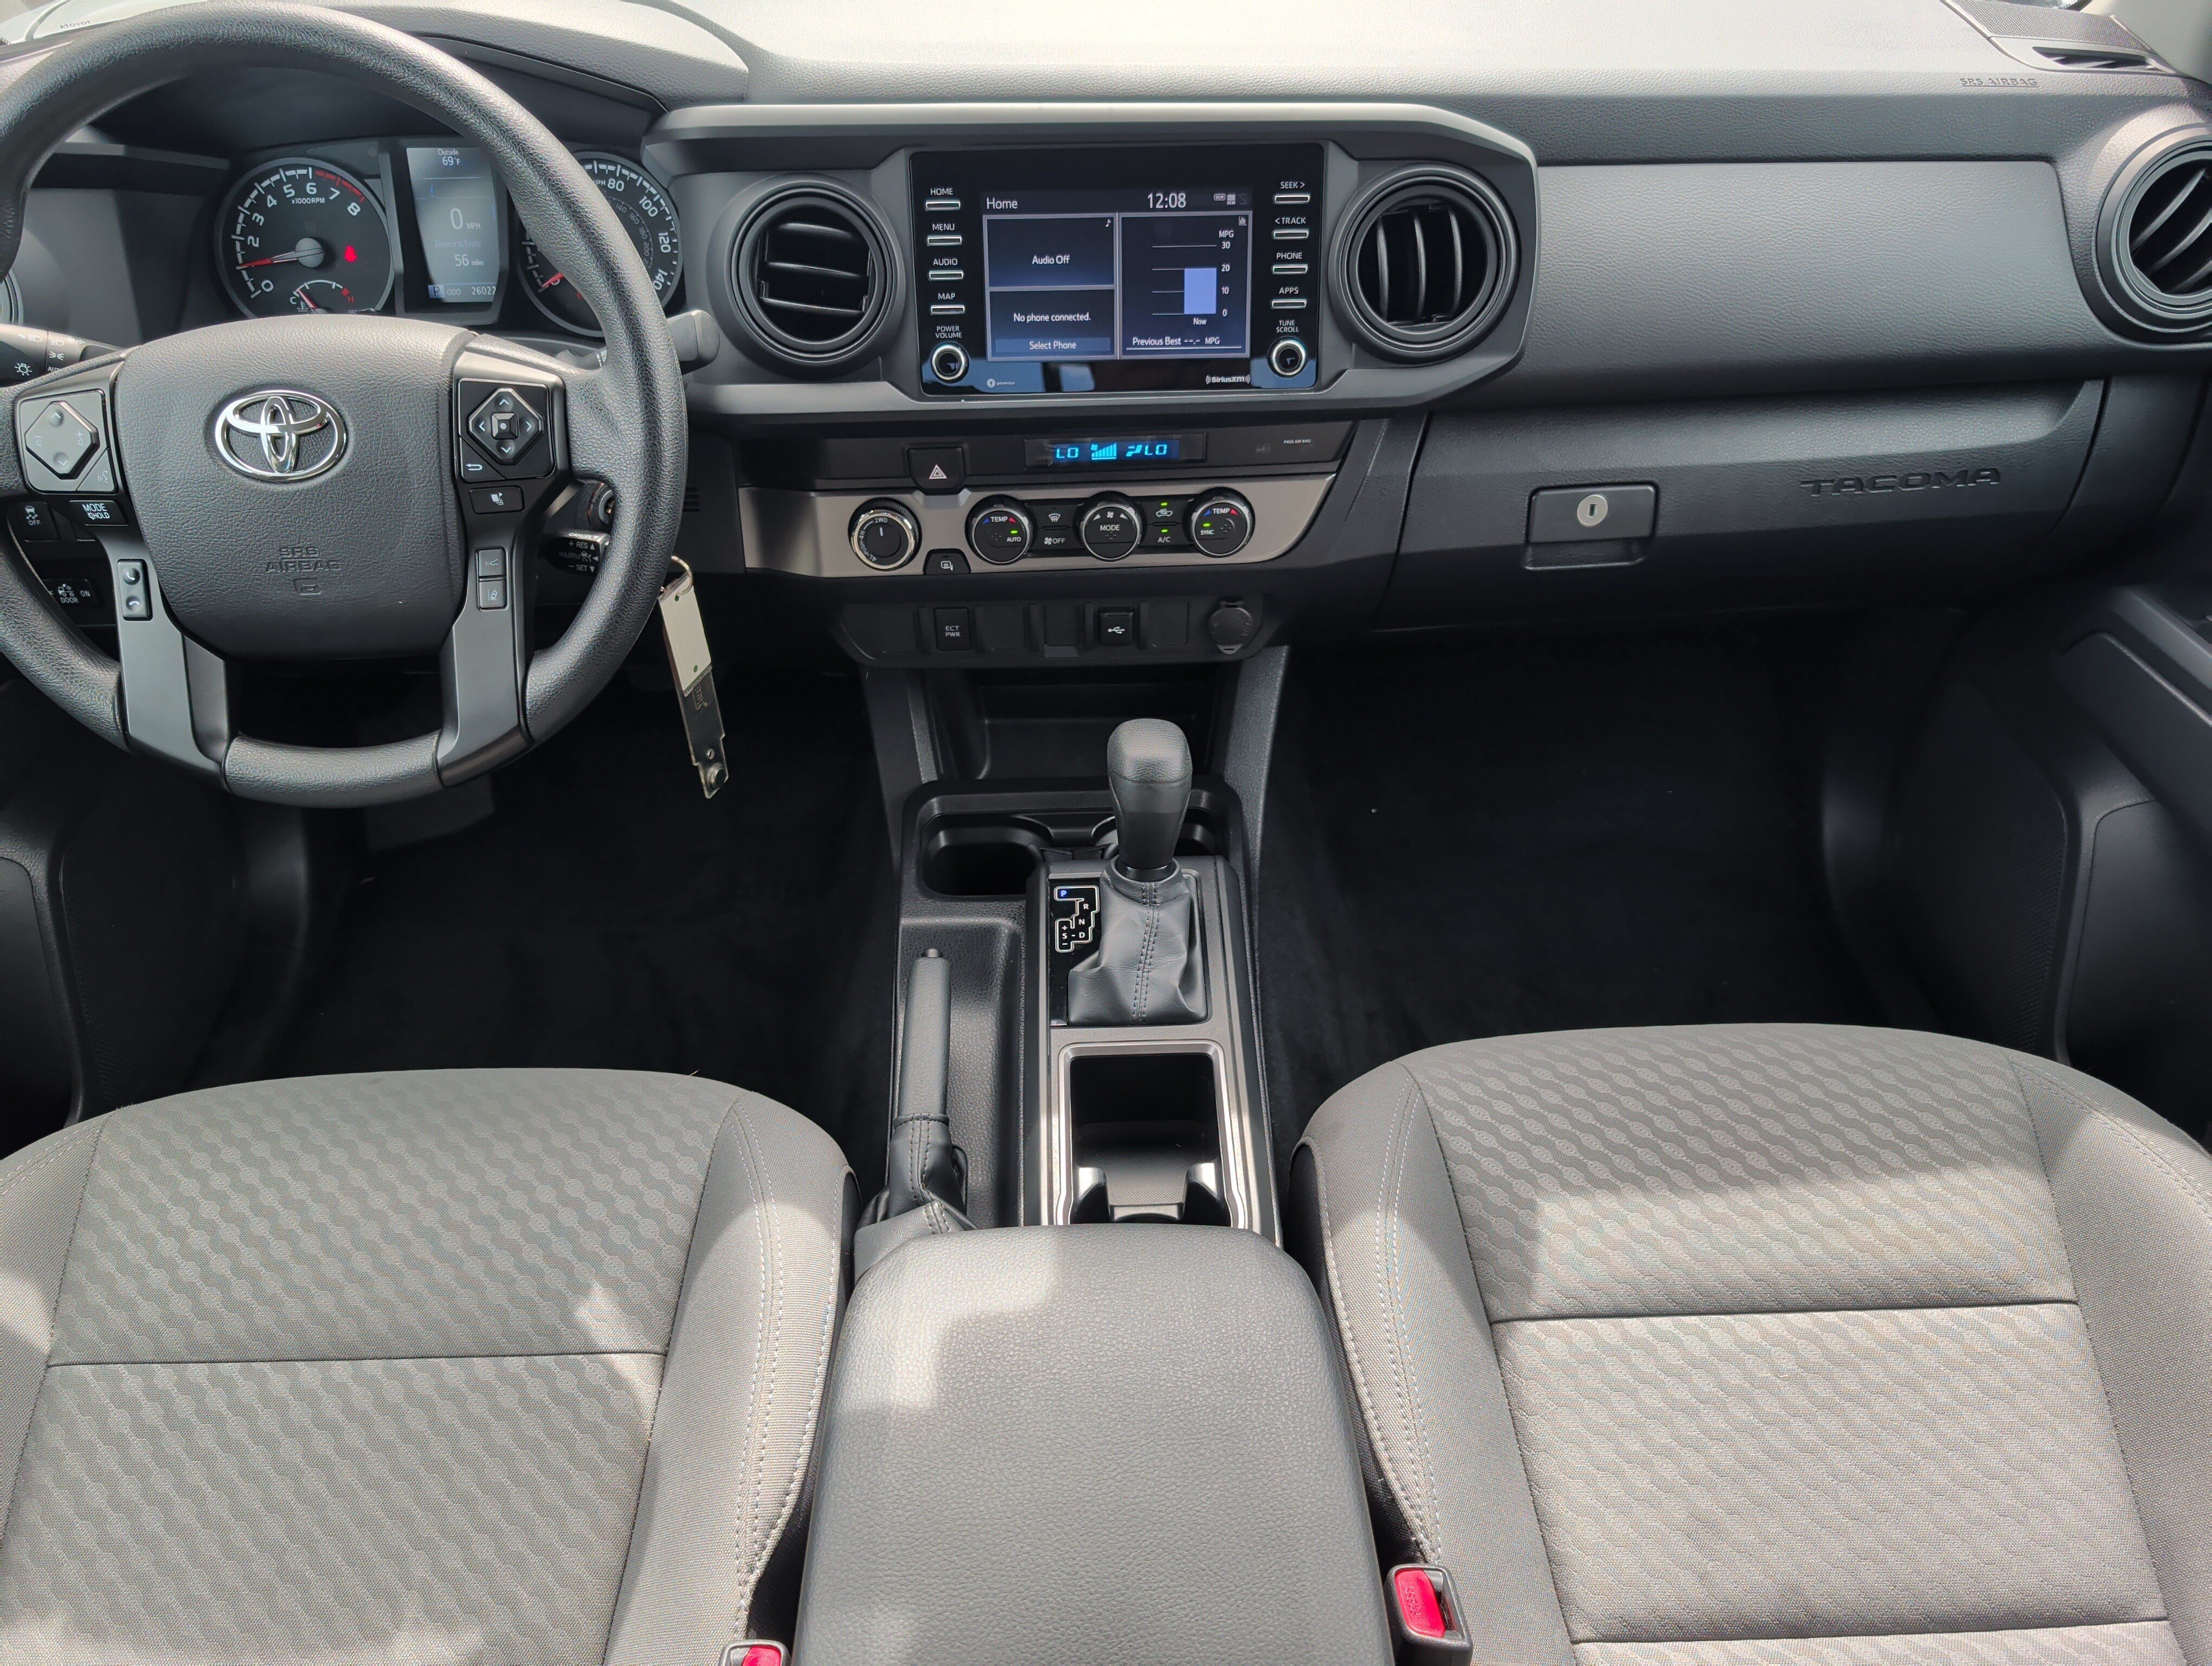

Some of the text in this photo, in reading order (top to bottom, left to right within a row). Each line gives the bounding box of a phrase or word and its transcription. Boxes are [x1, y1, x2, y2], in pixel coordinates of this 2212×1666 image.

[1988, 78, 2039, 86] AIRBAG
[283, 184, 295, 198] 5
[306, 182, 317, 194] 6
[607, 178, 625, 192] 80
[329, 188, 340, 200] 7
[267, 195, 277, 208] 4
[639, 196, 658, 217] 100
[987, 198, 1018, 209] Home
[1148, 193, 1186, 208] 12:08
[347, 202, 361, 216] 8
[252, 213, 265, 226] 3
[451, 208, 463, 229] 0
[1219, 230, 1234, 239] MPG
[248, 236, 259, 248] 2
[658, 232, 671, 253] 120
[454, 254, 469, 267] 56
[1032, 255, 1070, 265] Audio Off
[653, 268, 668, 290] 140
[261, 279, 274, 292] 0
[433, 286, 440, 297] P
[1014, 313, 1091, 323] No phone connected.
[1030, 341, 1076, 349] Select Phone
[1165, 337, 1181, 345] Best
[1056, 447, 1079, 459] LO
[1144, 444, 1167, 456] LO
[1801, 468, 2000, 497] TACOMA
[82, 503, 108, 512] MODE
[279, 547, 320, 557] SRS
[266, 560, 341, 573] AIRBAG
